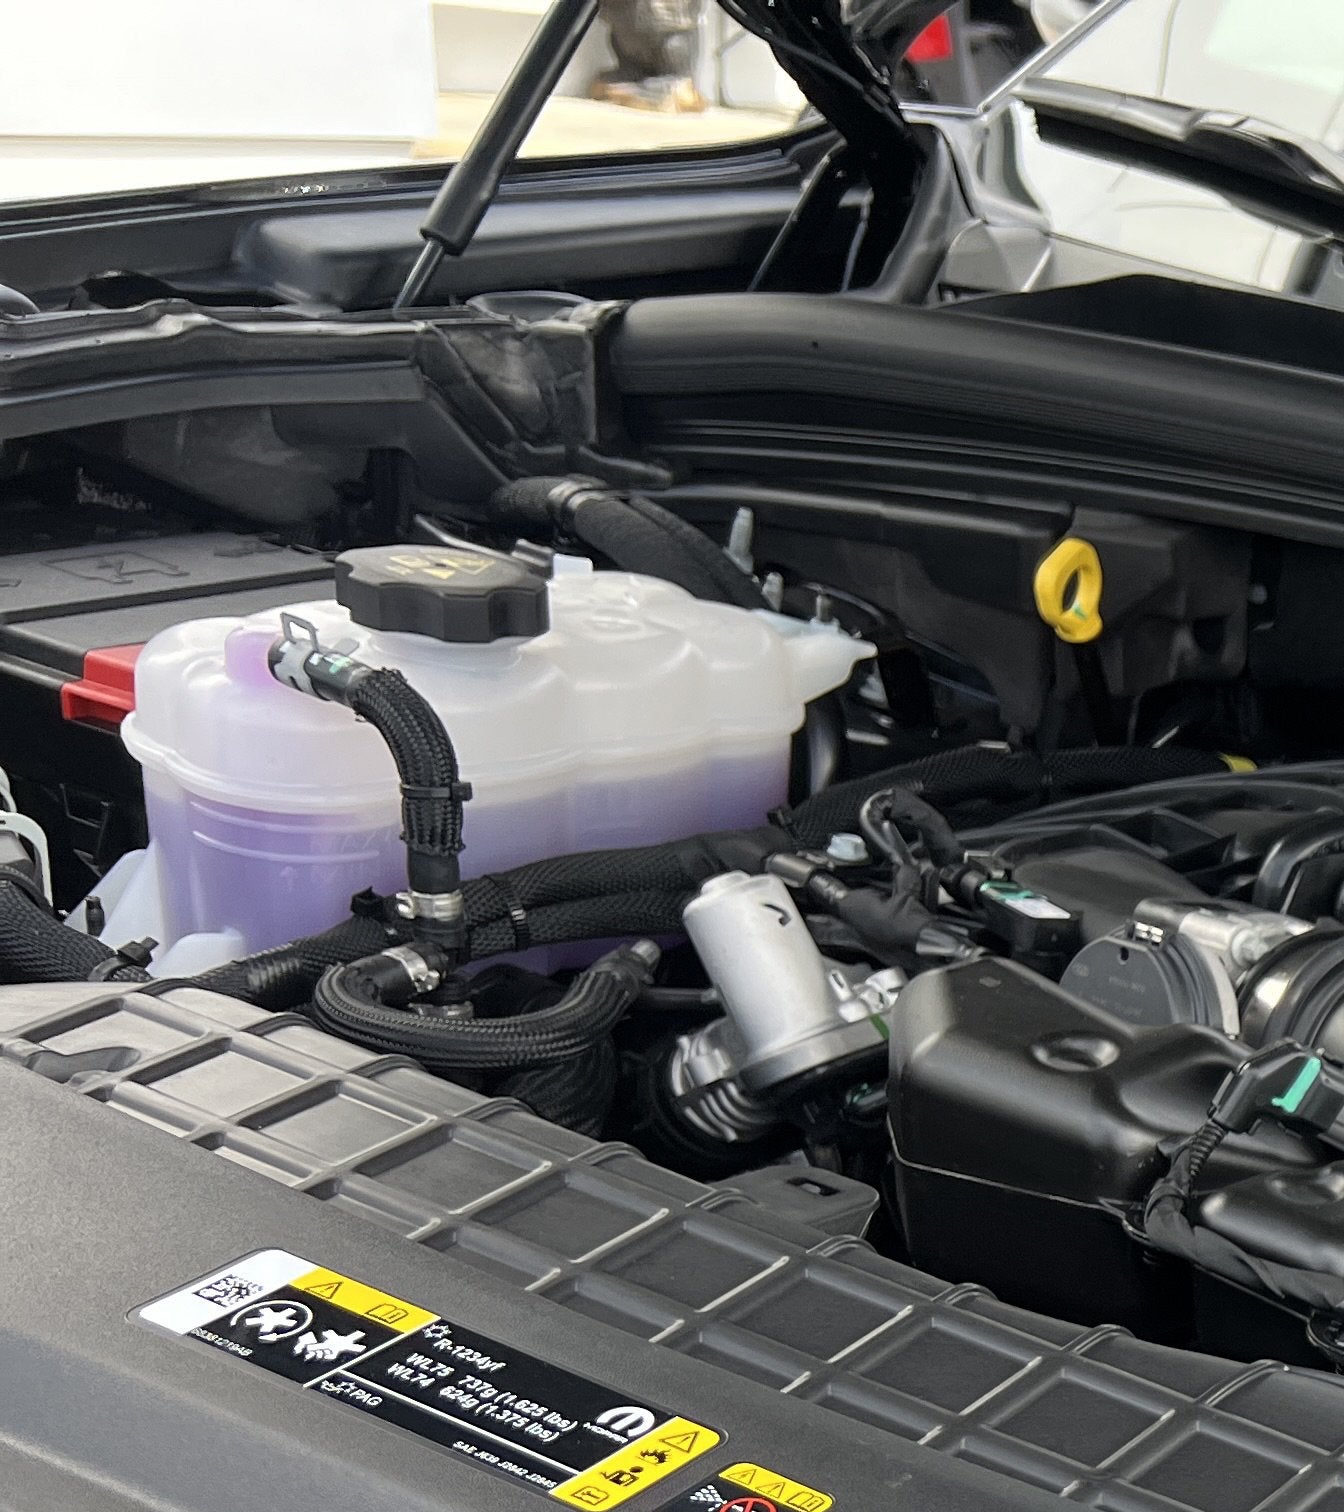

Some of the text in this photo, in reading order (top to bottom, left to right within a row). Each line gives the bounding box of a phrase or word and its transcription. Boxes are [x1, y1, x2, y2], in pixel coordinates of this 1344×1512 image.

[433, 1337, 507, 1372] R-1234yf
[349, 1388, 383, 1407] PAG
[386, 1362, 561, 1444] WL74 624g (1.375 lbs)
[405, 1352, 579, 1432] WL75 737g (1.625 lbs)
[452, 1440, 478, 1455] SAE
